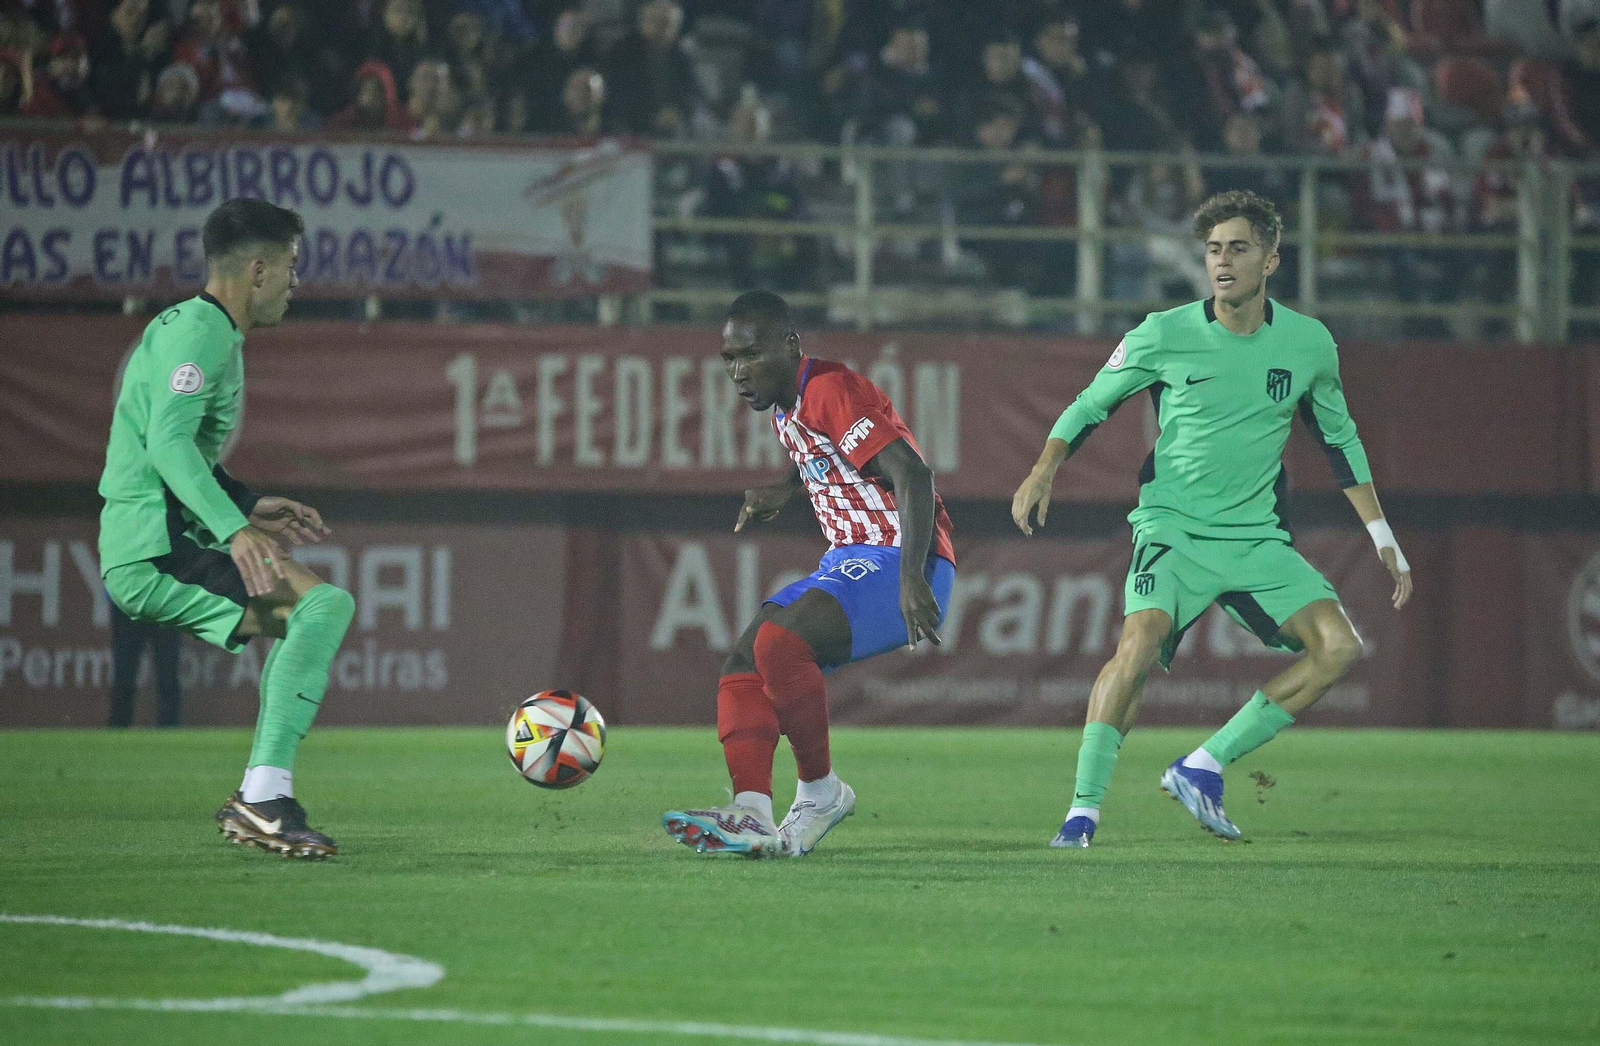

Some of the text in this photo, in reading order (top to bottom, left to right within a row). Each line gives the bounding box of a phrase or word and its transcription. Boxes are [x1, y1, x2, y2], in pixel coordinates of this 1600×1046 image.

[0, 149, 415, 209] LLO ALBIRROJO
[94, 227, 154, 281] EN
[174, 226, 206, 282] E
[297, 211, 474, 284] RAZÓN
[535, 345, 962, 472] FEDERAÓN
[0, 539, 452, 630] HYAI
[1133, 542, 1173, 574] 17
